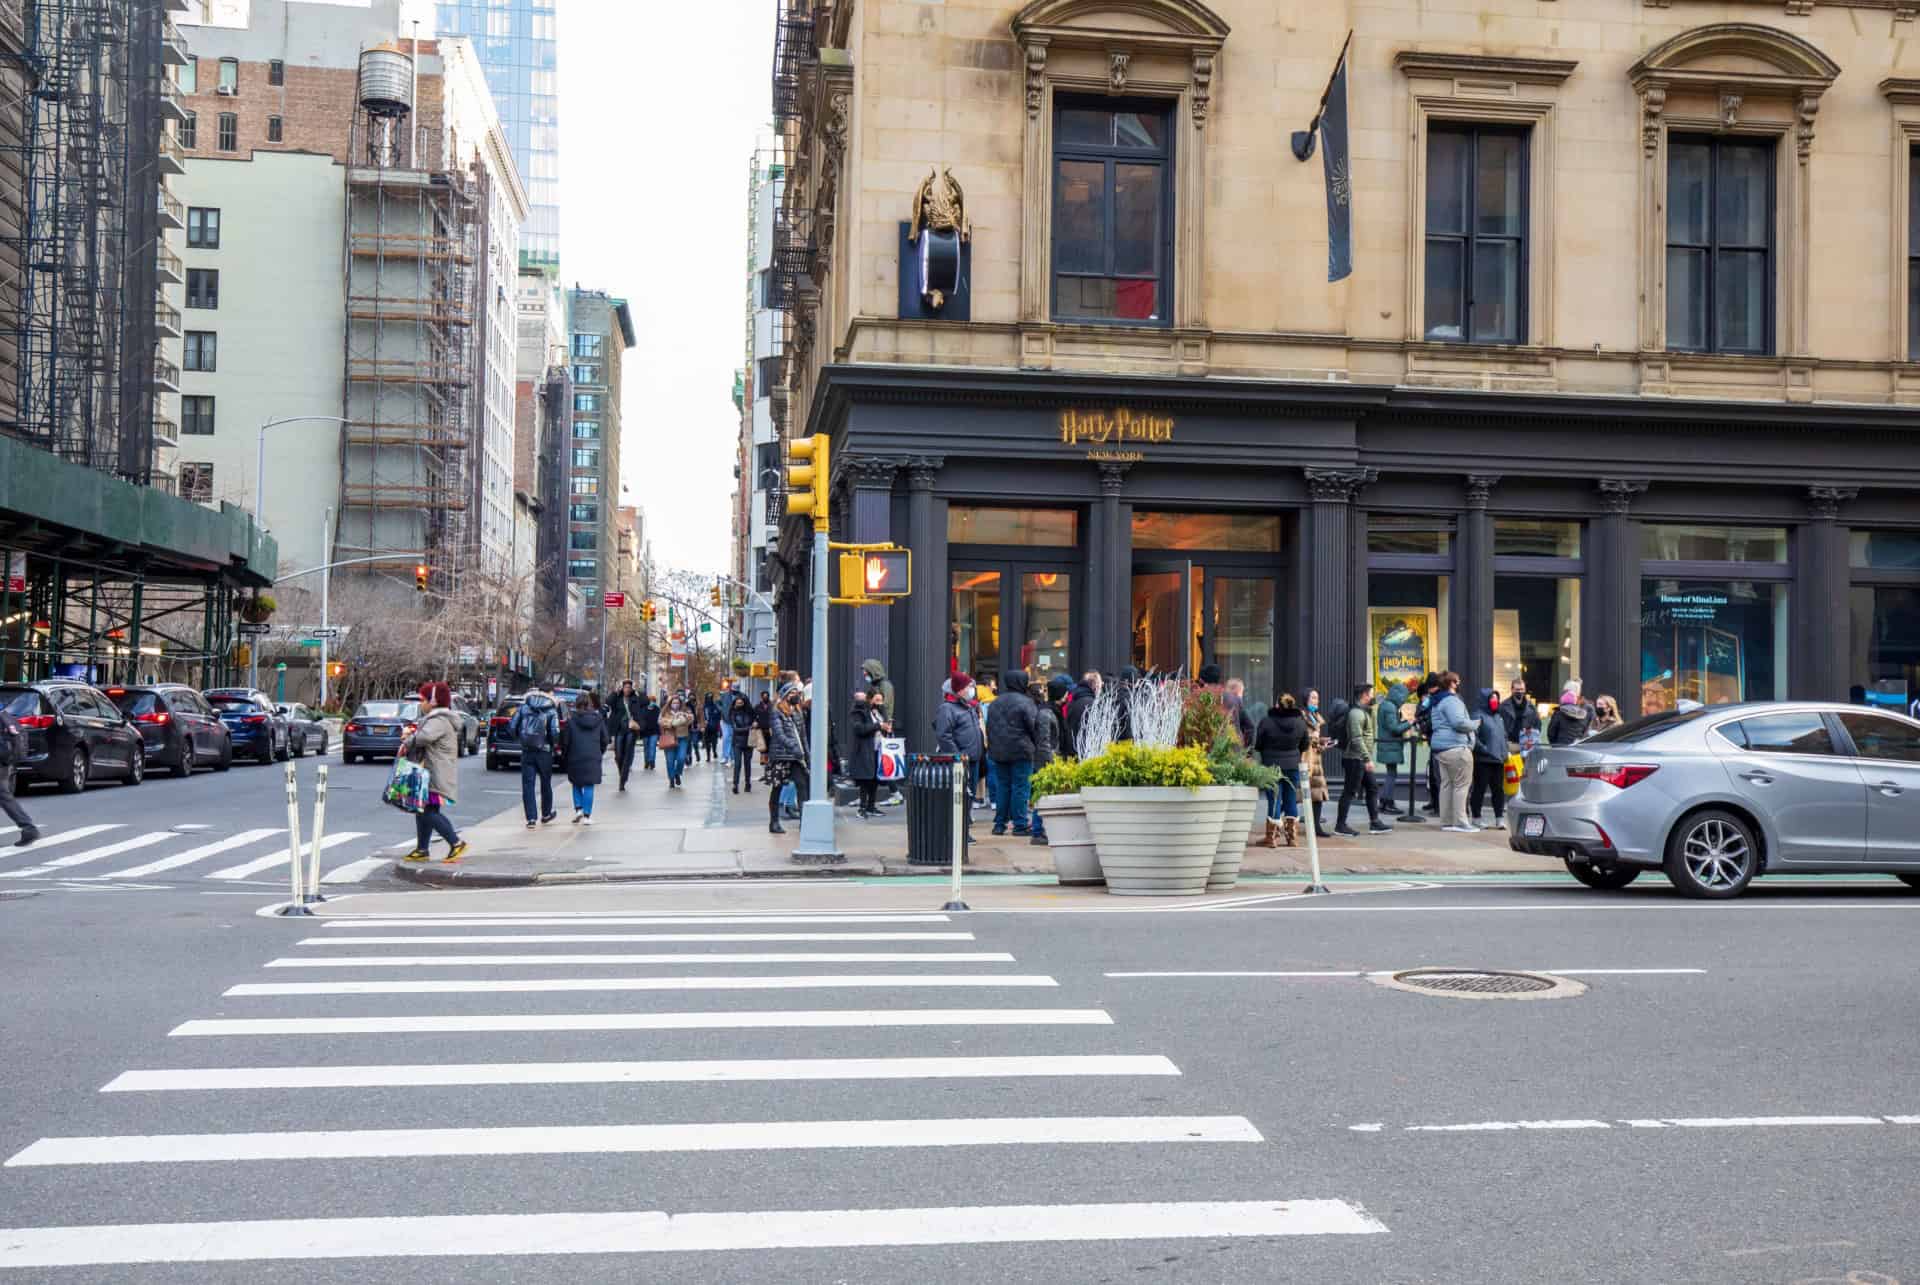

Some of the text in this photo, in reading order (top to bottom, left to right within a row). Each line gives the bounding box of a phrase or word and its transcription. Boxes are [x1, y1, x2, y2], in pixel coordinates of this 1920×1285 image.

[1060, 408, 1174, 450] Harry Potter
[1087, 449, 1145, 461] NEW YORK
